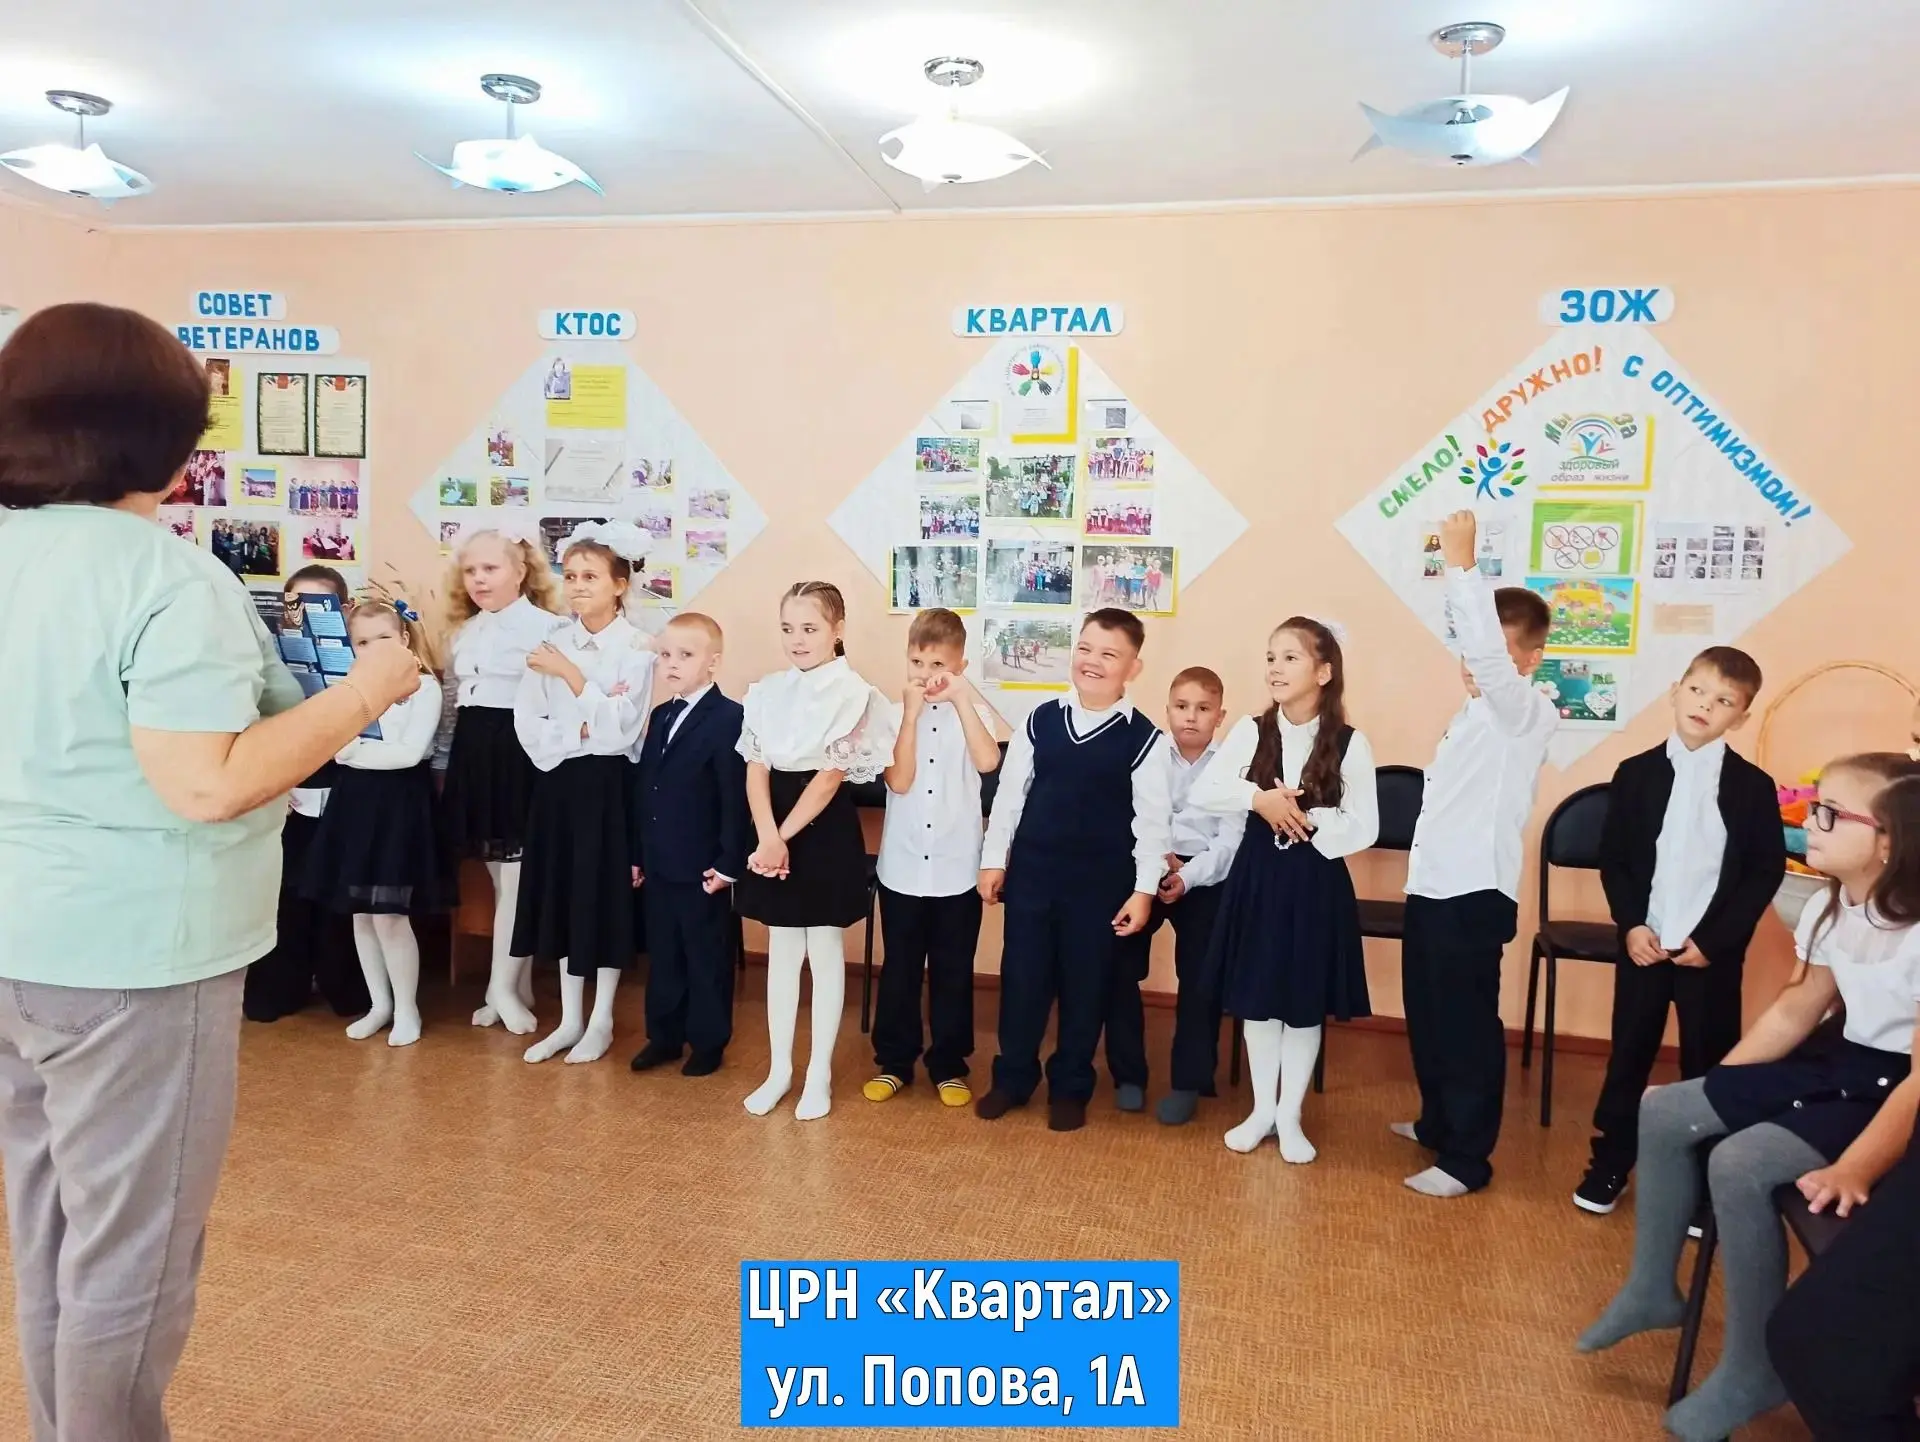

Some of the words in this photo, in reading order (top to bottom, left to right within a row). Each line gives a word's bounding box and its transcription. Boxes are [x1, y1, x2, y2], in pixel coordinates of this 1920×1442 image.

[198, 292, 272, 317] СОВЕТ
[1560, 289, 1660, 323] ЗОЖ
[556, 312, 621, 336] КТОС
[967, 307, 1112, 333] КВАРТАЛ
[178, 326, 320, 351] ВЕТЕРАНОВ
[1378, 434, 1463, 519] СМЕЛО!
[1481, 345, 1602, 433] ДРУЖНО!
[1651, 370, 1811, 527] ОПТИМИЗМОМ!
